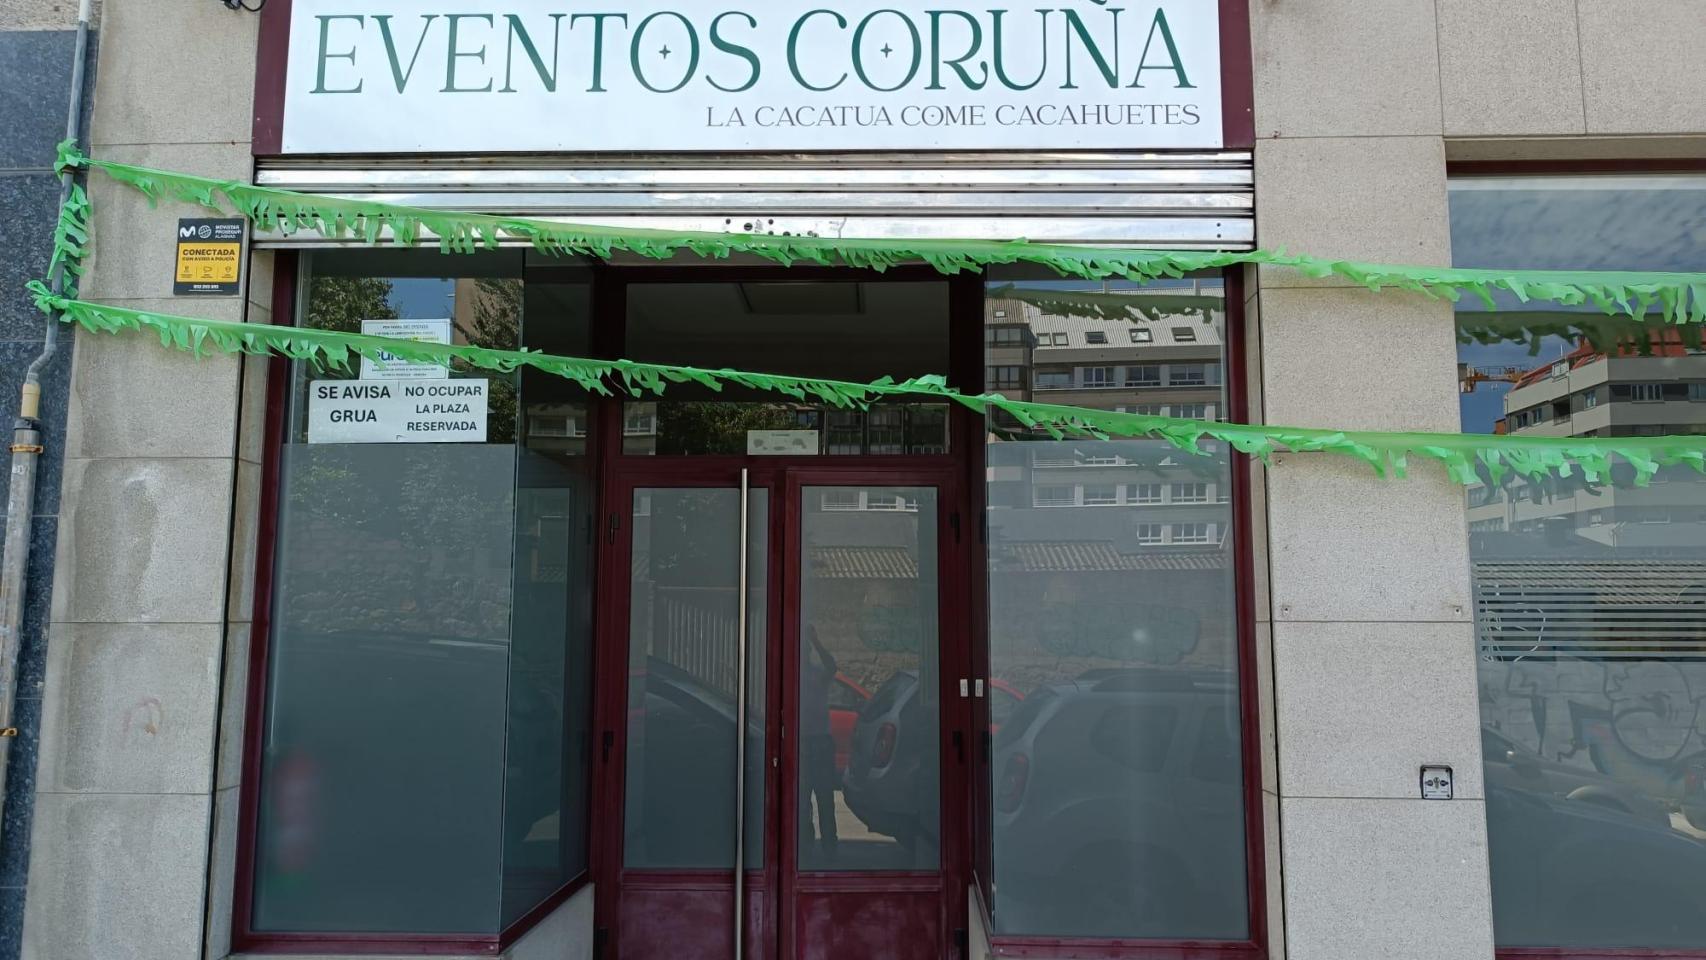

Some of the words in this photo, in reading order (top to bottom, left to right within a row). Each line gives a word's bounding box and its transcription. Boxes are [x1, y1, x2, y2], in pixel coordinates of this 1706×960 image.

[309, 11, 761, 94] EVENTOS
[786, 0, 1198, 92] CORUÑA
[706, 107, 745, 127] LA
[754, 106, 894, 127] CACATUA
[900, 105, 986, 127] COME
[995, 104, 1201, 126] CACAHUETES
[317, 386, 339, 400] SE
[342, 385, 391, 400] AVISA
[405, 386, 425, 397] NO
[428, 386, 482, 397] OCUPAR
[415, 404, 431, 414] LA
[432, 403, 470, 414] PLAZA
[329, 409, 378, 423] GRUA
[406, 421, 477, 432] RESERVADA
